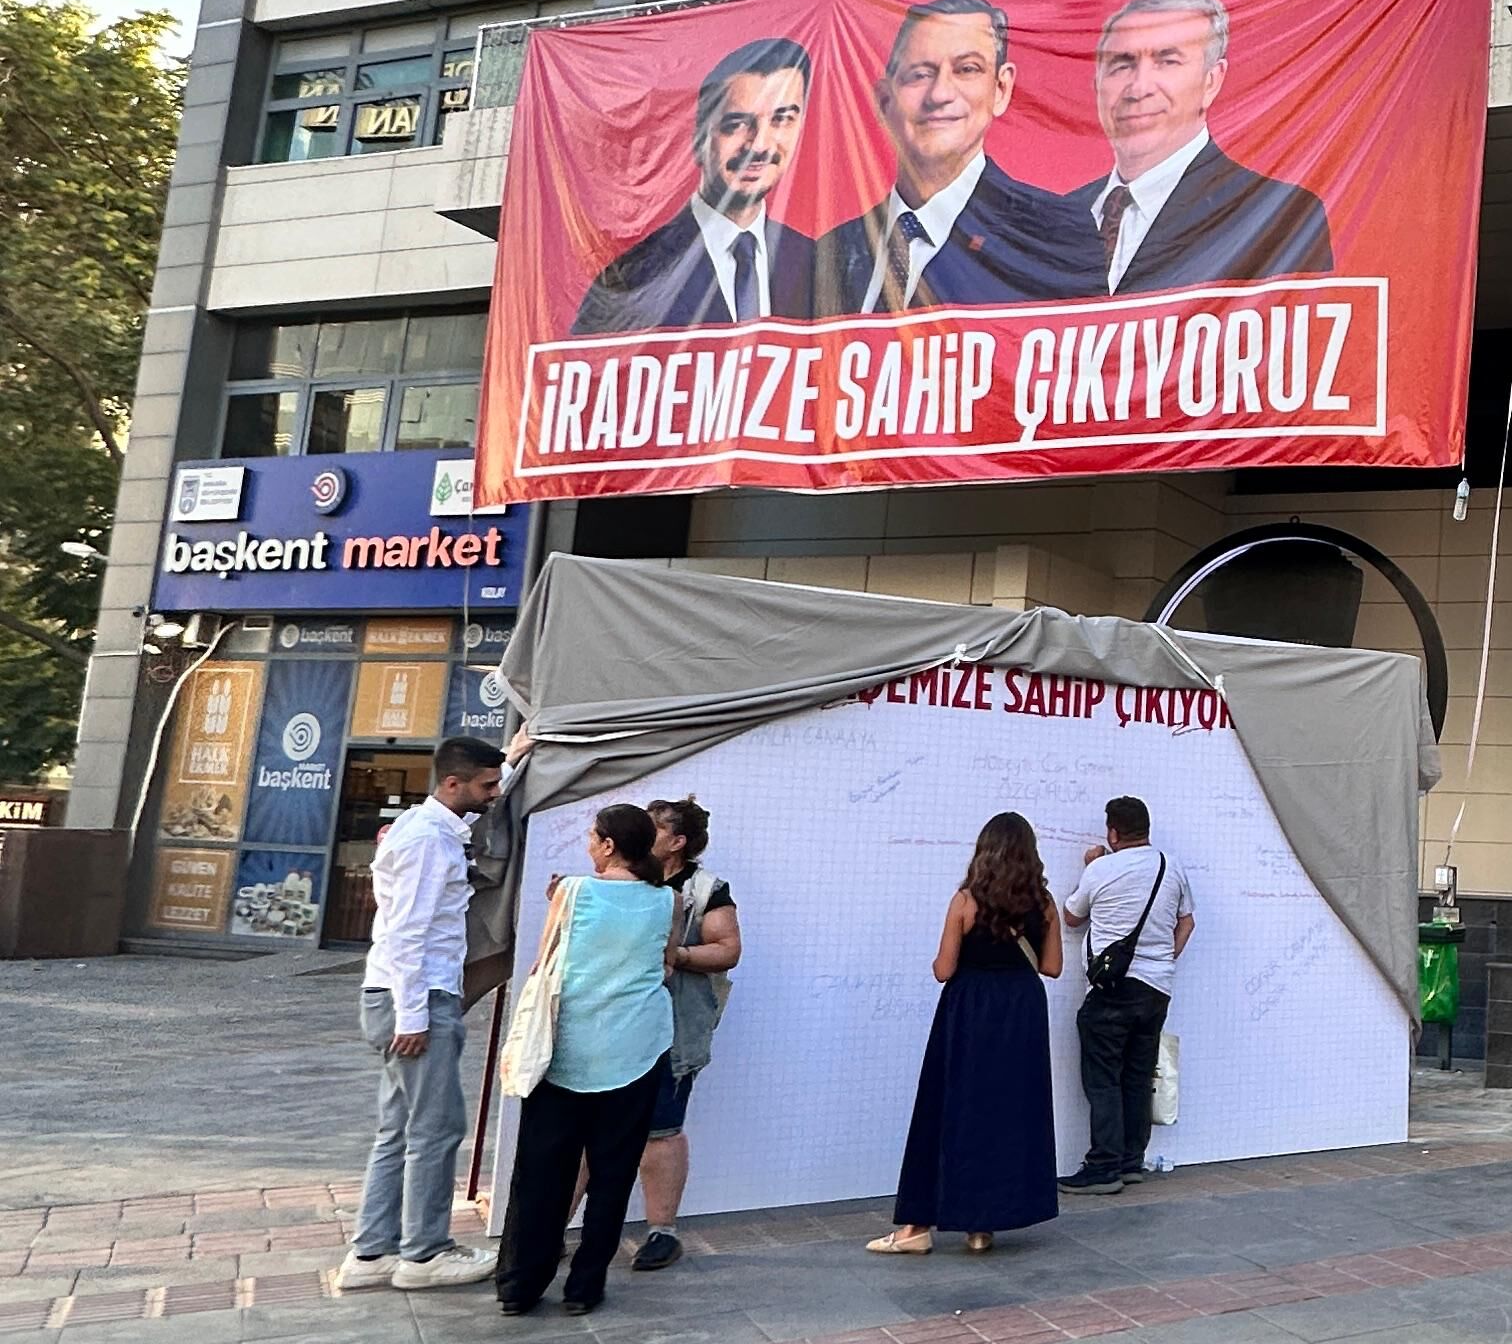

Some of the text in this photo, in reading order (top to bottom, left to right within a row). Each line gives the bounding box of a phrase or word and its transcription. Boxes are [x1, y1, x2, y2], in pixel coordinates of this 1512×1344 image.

[836, 330, 995, 442] SAHİP
[1015, 300, 1353, 445] ÇIKIYORUZ
[163, 526, 501, 579] başkent market
[1004, 667, 1106, 718] SAHİP
[258, 765, 331, 791] başkent
